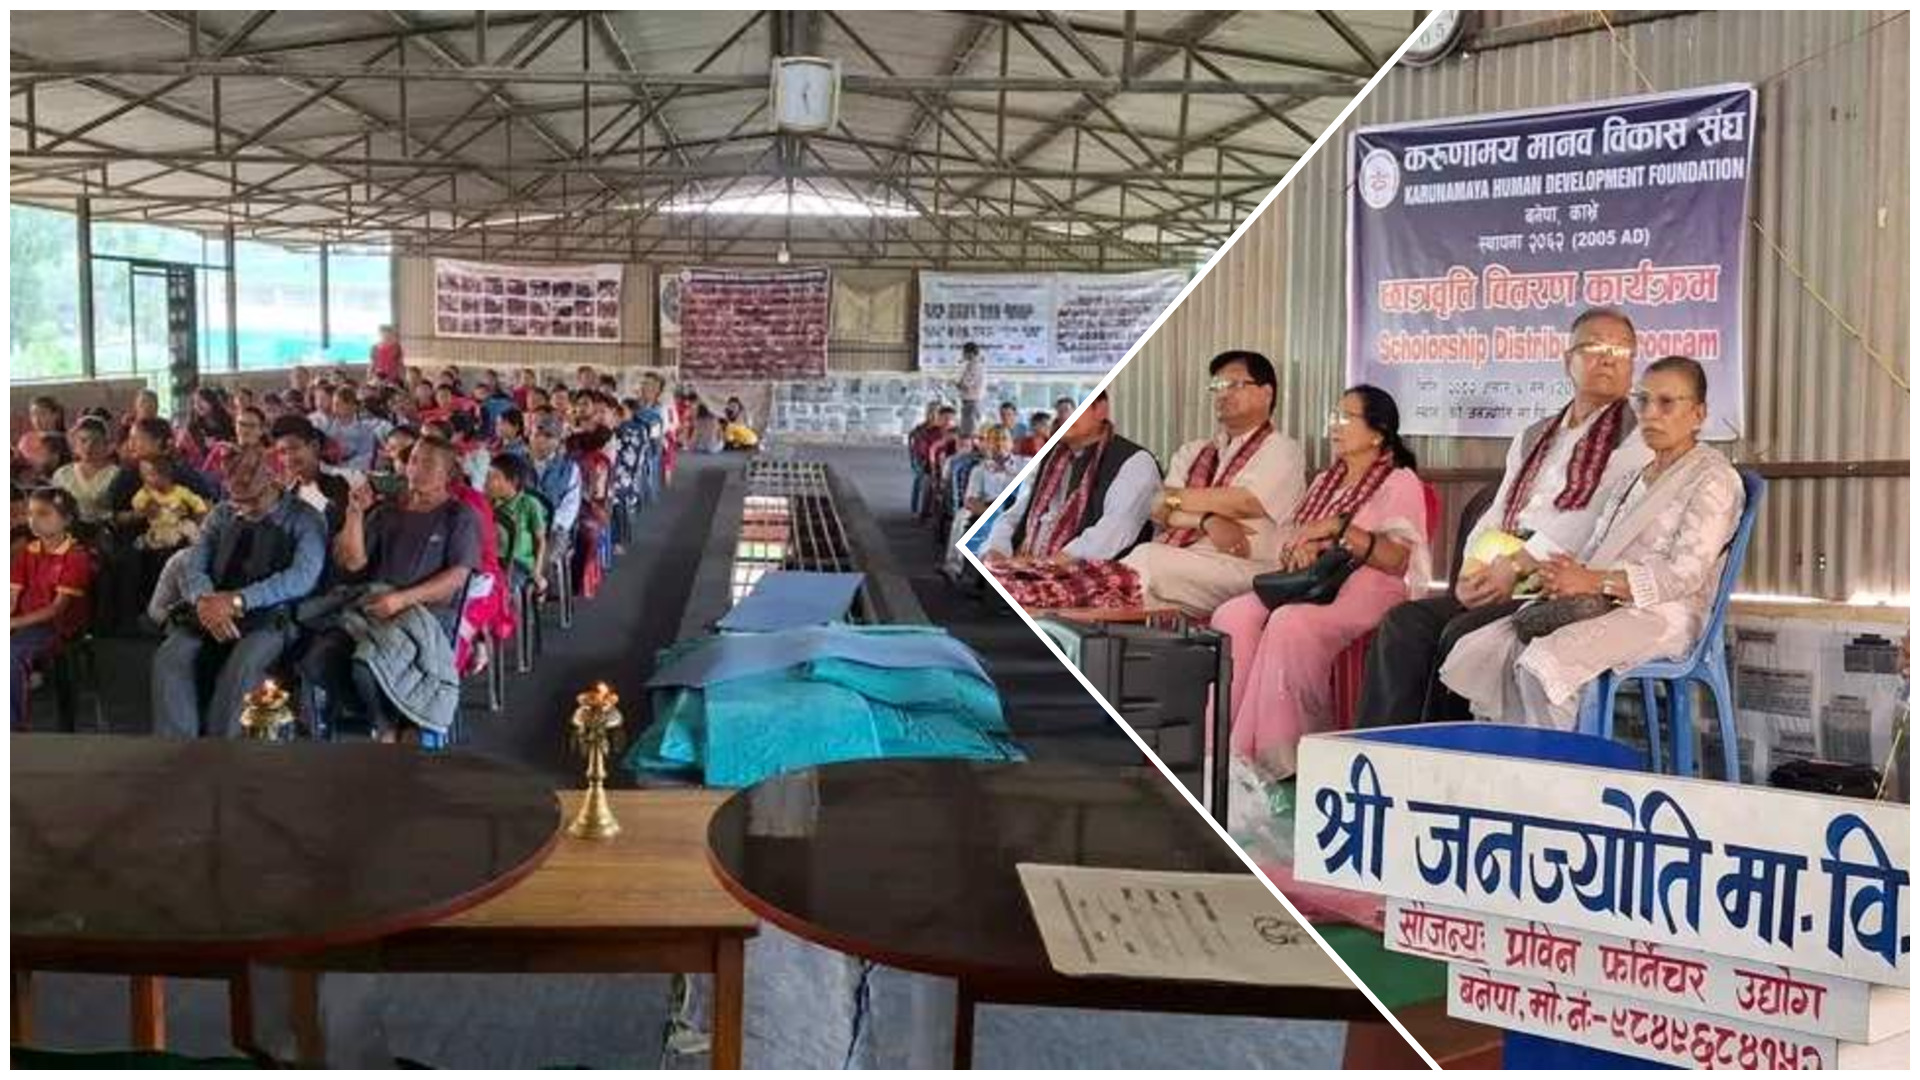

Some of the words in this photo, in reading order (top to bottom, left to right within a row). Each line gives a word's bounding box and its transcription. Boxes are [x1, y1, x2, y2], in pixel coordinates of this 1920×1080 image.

[1527, 127, 1596, 160] मानव
[1602, 115, 1689, 154] विकास
[1697, 108, 1746, 147] संघ
[1404, 179, 1490, 205] KARUNAMAYA
[1492, 174, 1543, 199] HUMAN
[1545, 165, 1647, 194] DEVELOPMENT
[1649, 156, 1745, 186] FOUNDATION
[1571, 228, 1616, 250] (2005
[1619, 226, 1651, 247] AD)
[1483, 263, 1579, 307] वितरण
[1583, 259, 1721, 306] कार्यक्रम
[1635, 329, 1719, 361] rogram
[1315, 752, 1394, 882] श्री
[1407, 786, 1713, 935] जनज्योति
[1716, 843, 1813, 950] मा.
[1733, 965, 1828, 1021] उद्योग
